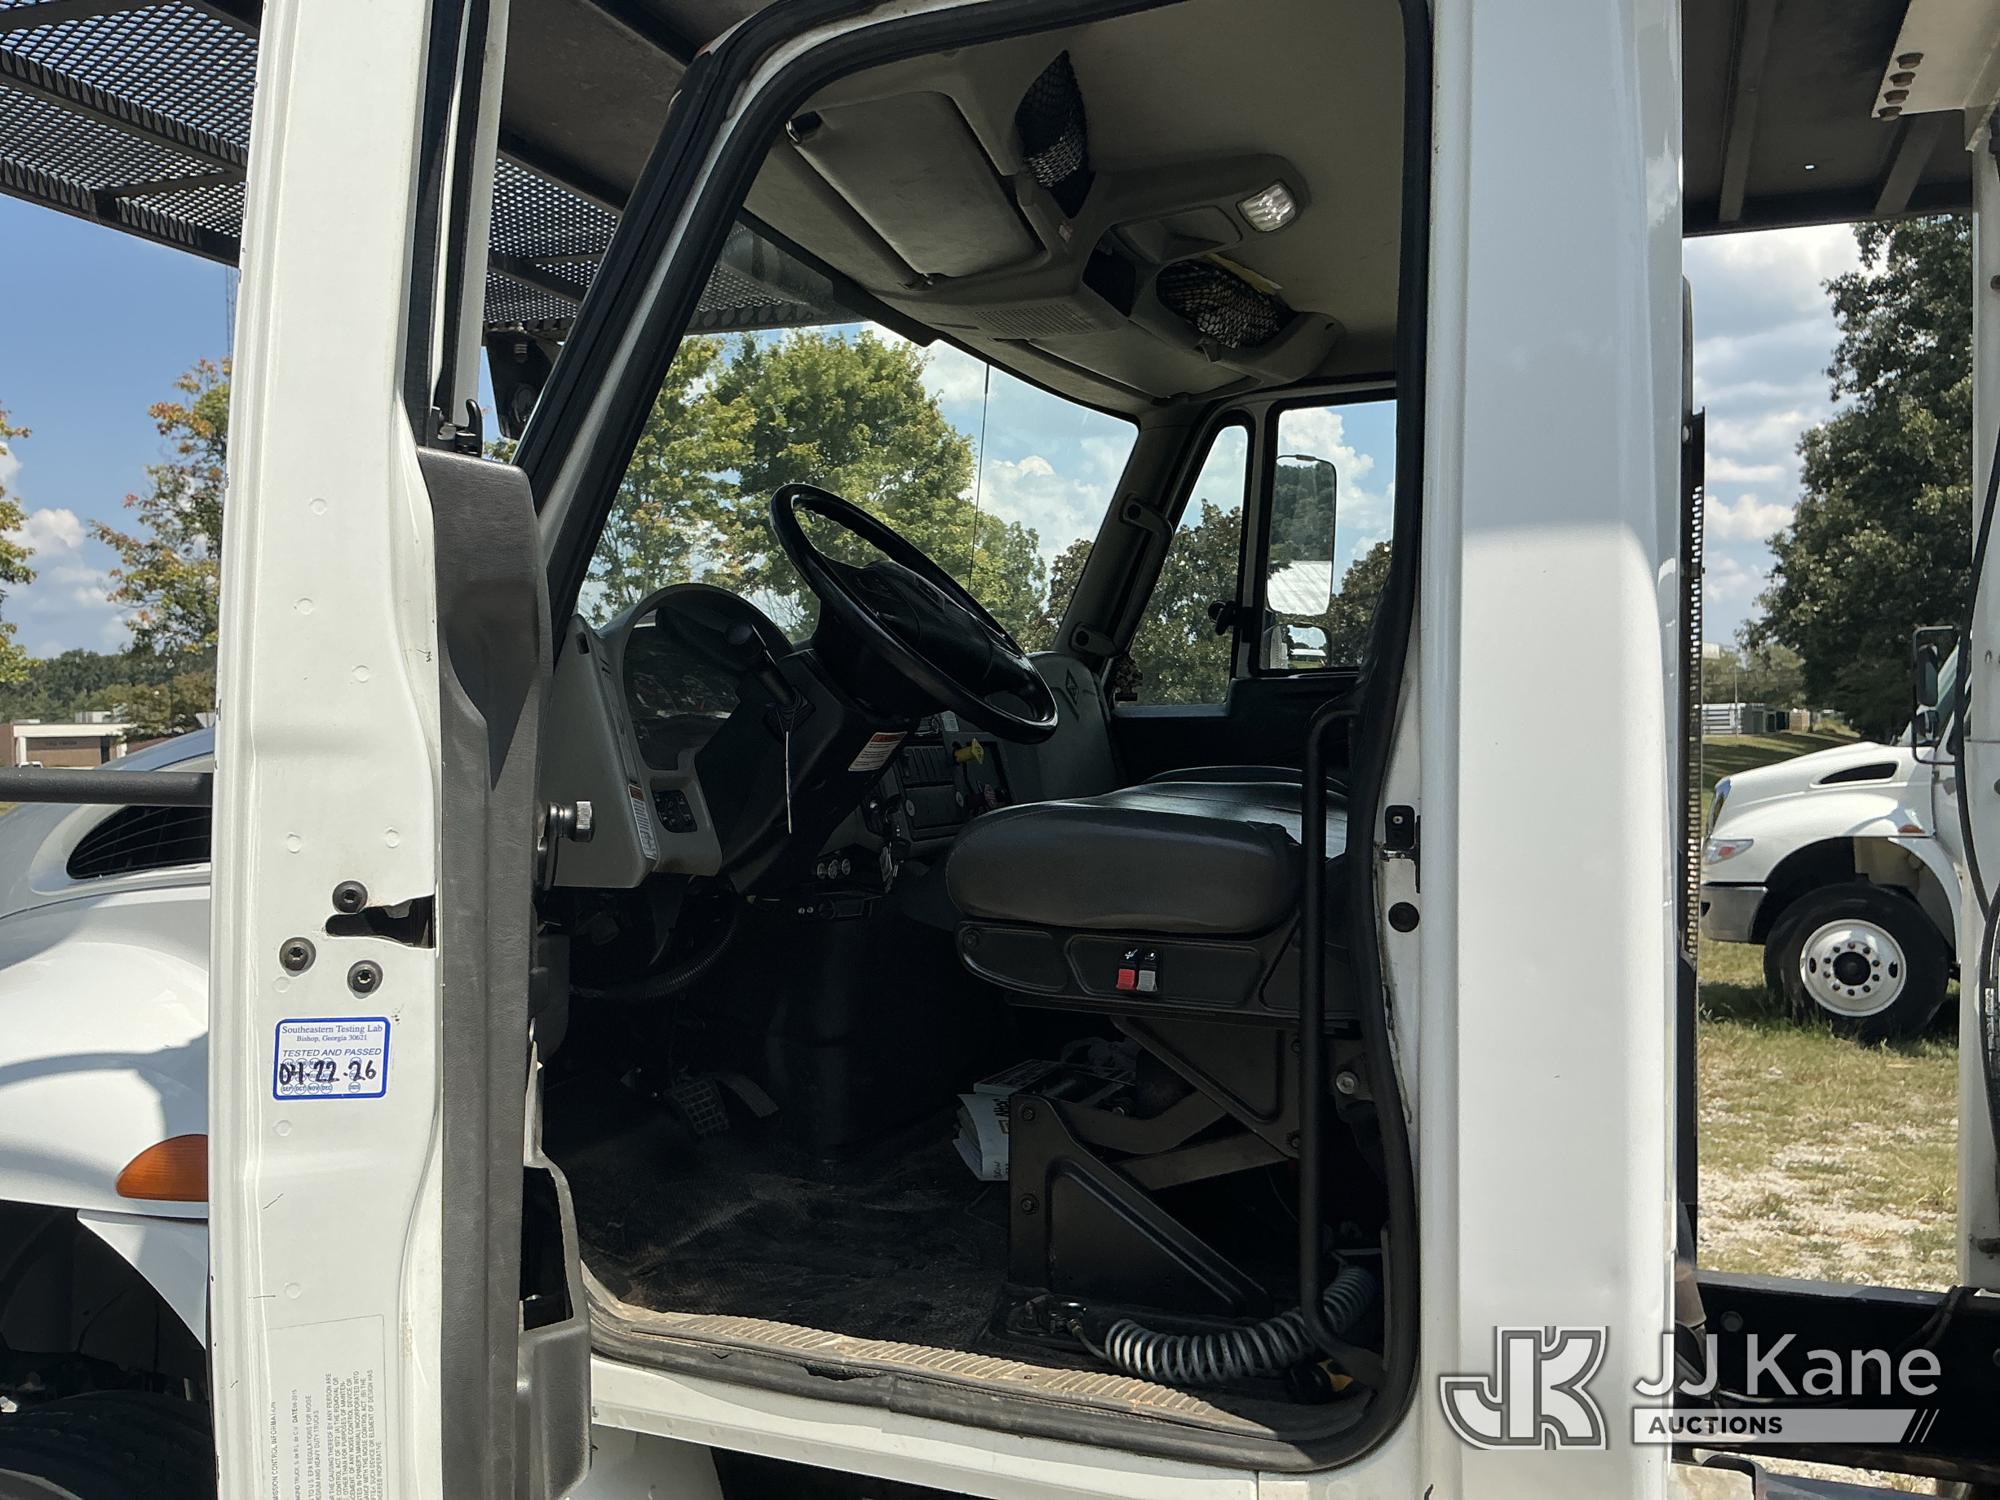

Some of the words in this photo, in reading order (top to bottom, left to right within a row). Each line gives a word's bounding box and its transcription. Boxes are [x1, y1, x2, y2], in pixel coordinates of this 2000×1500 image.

[282, 1026, 333, 1034] Southeastern
[336, 1025, 365, 1034] Testing
[283, 1049, 320, 1057] TESTED
[322, 1048, 342, 1056] AND
[344, 1048, 382, 1056] PASSED
